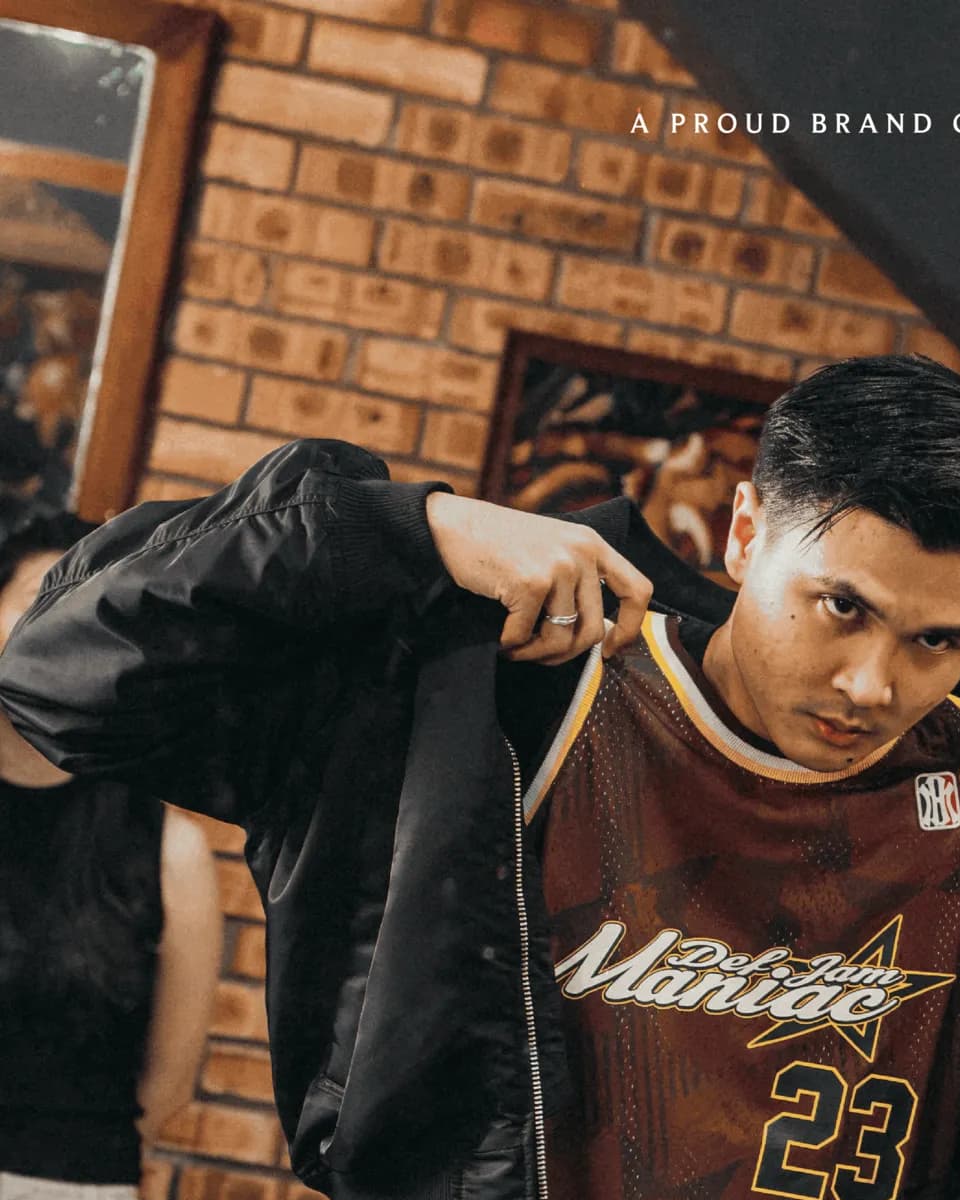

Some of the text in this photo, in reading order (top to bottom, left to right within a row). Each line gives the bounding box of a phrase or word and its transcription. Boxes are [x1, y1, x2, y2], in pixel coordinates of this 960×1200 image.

[554, 920, 901, 1025] Maniac
[664, 937, 908, 989] Def Jam
